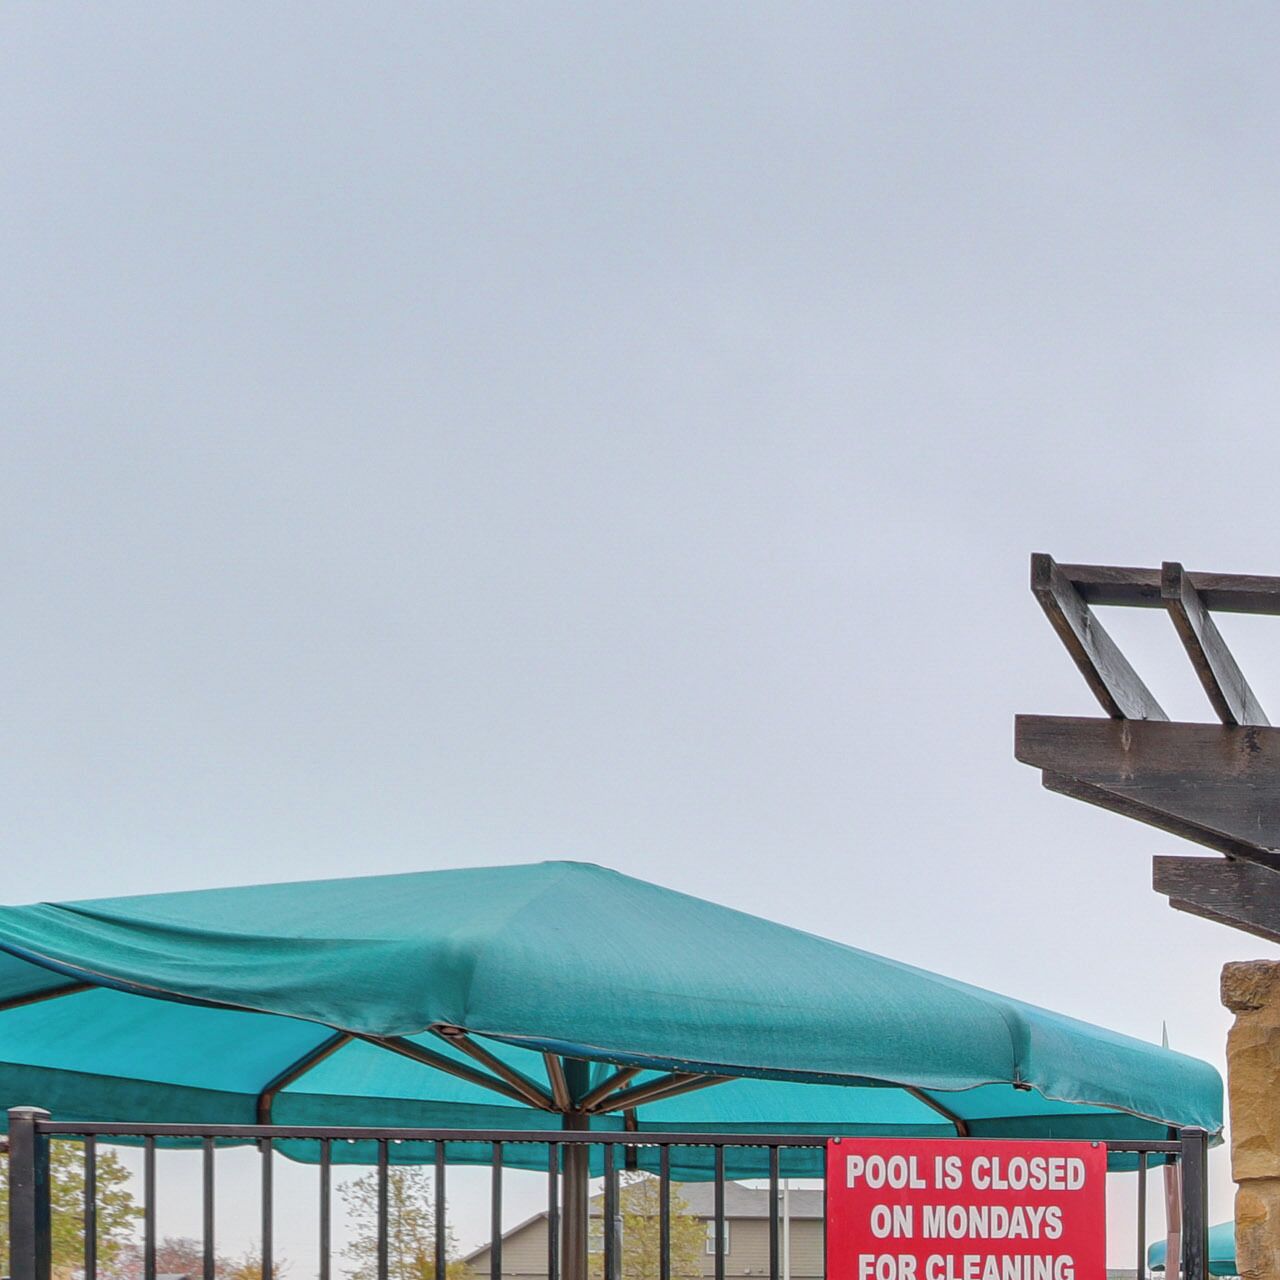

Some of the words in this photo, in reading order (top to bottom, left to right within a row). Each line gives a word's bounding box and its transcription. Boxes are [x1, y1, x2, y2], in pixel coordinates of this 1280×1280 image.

[846, 1155, 926, 1189] POOL
[934, 1155, 963, 1190] IS
[971, 1156, 1086, 1191] CLOSED
[870, 1205, 914, 1238] ON
[922, 1205, 1063, 1239] MONDAYS
